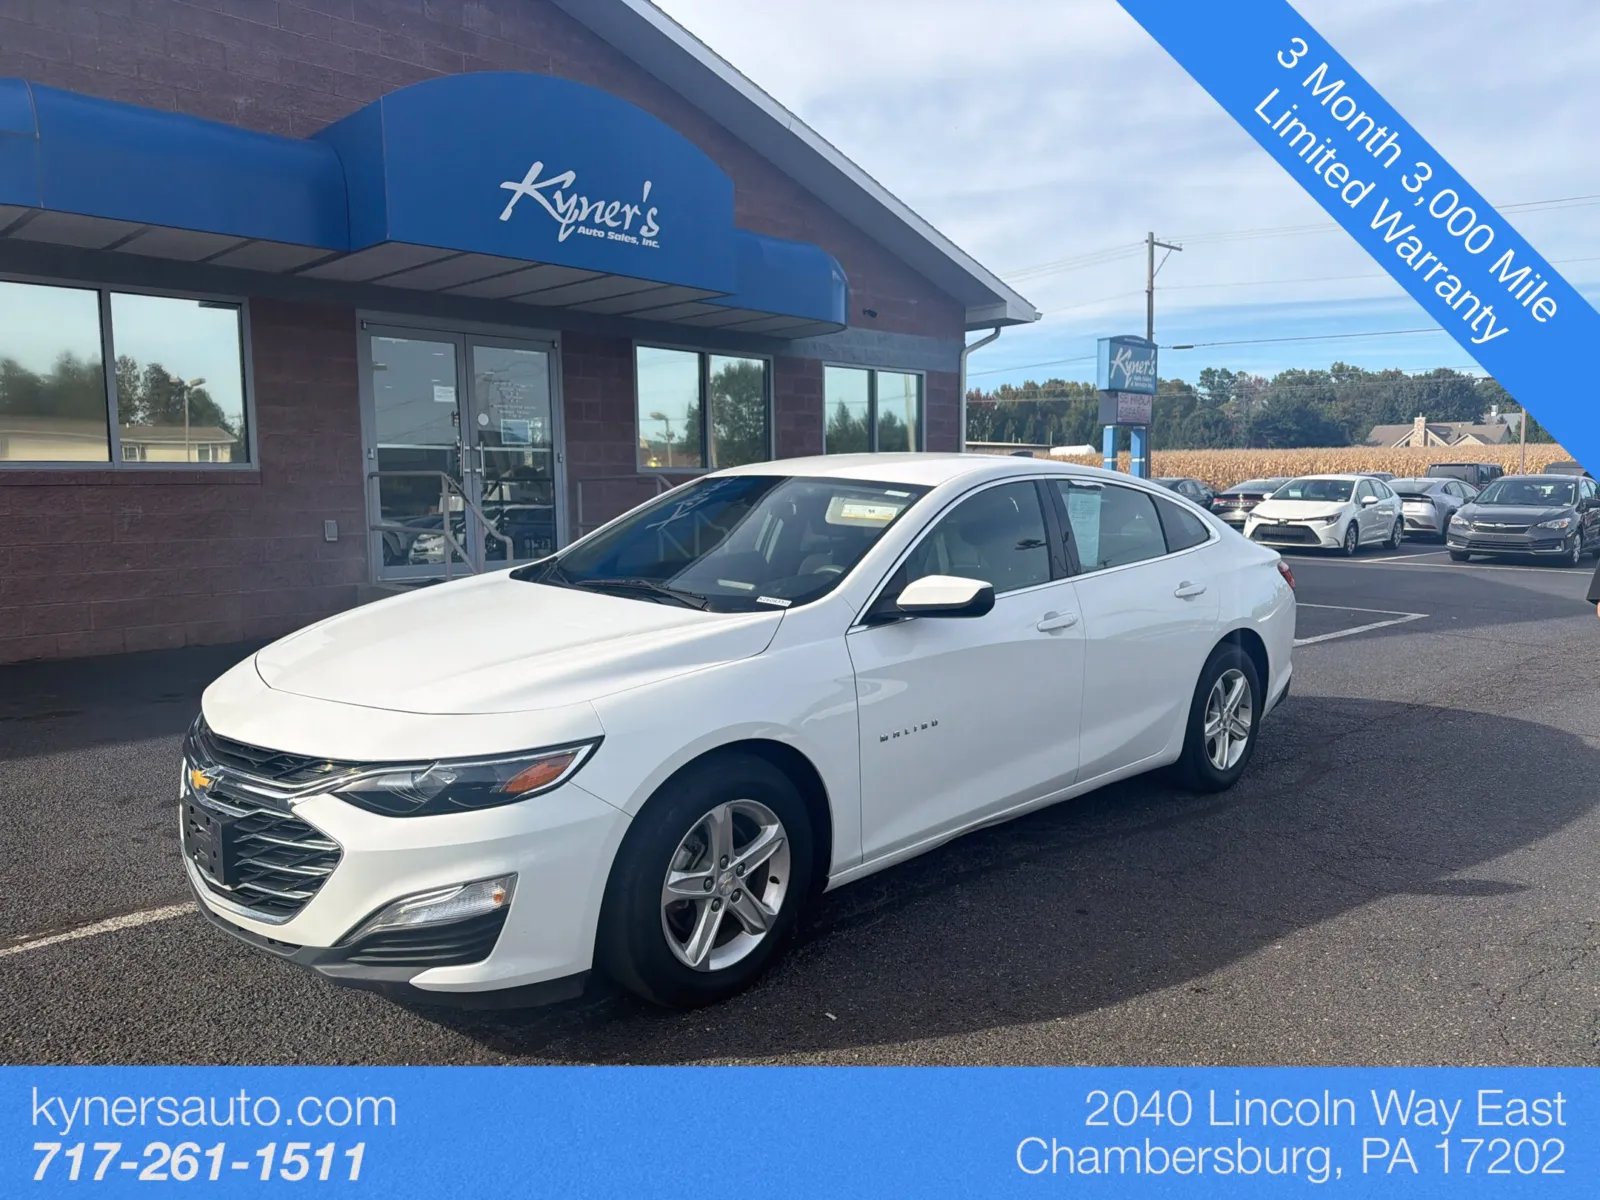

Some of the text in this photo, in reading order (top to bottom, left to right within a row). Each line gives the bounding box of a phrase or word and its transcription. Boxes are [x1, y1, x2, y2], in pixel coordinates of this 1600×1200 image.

[499, 160, 660, 243] Kyner's
[577, 226, 660, 248] Auto Sales, Inc.
[1110, 347, 1156, 389] Kyner's
[880, 718, 939, 743] MALIBU
